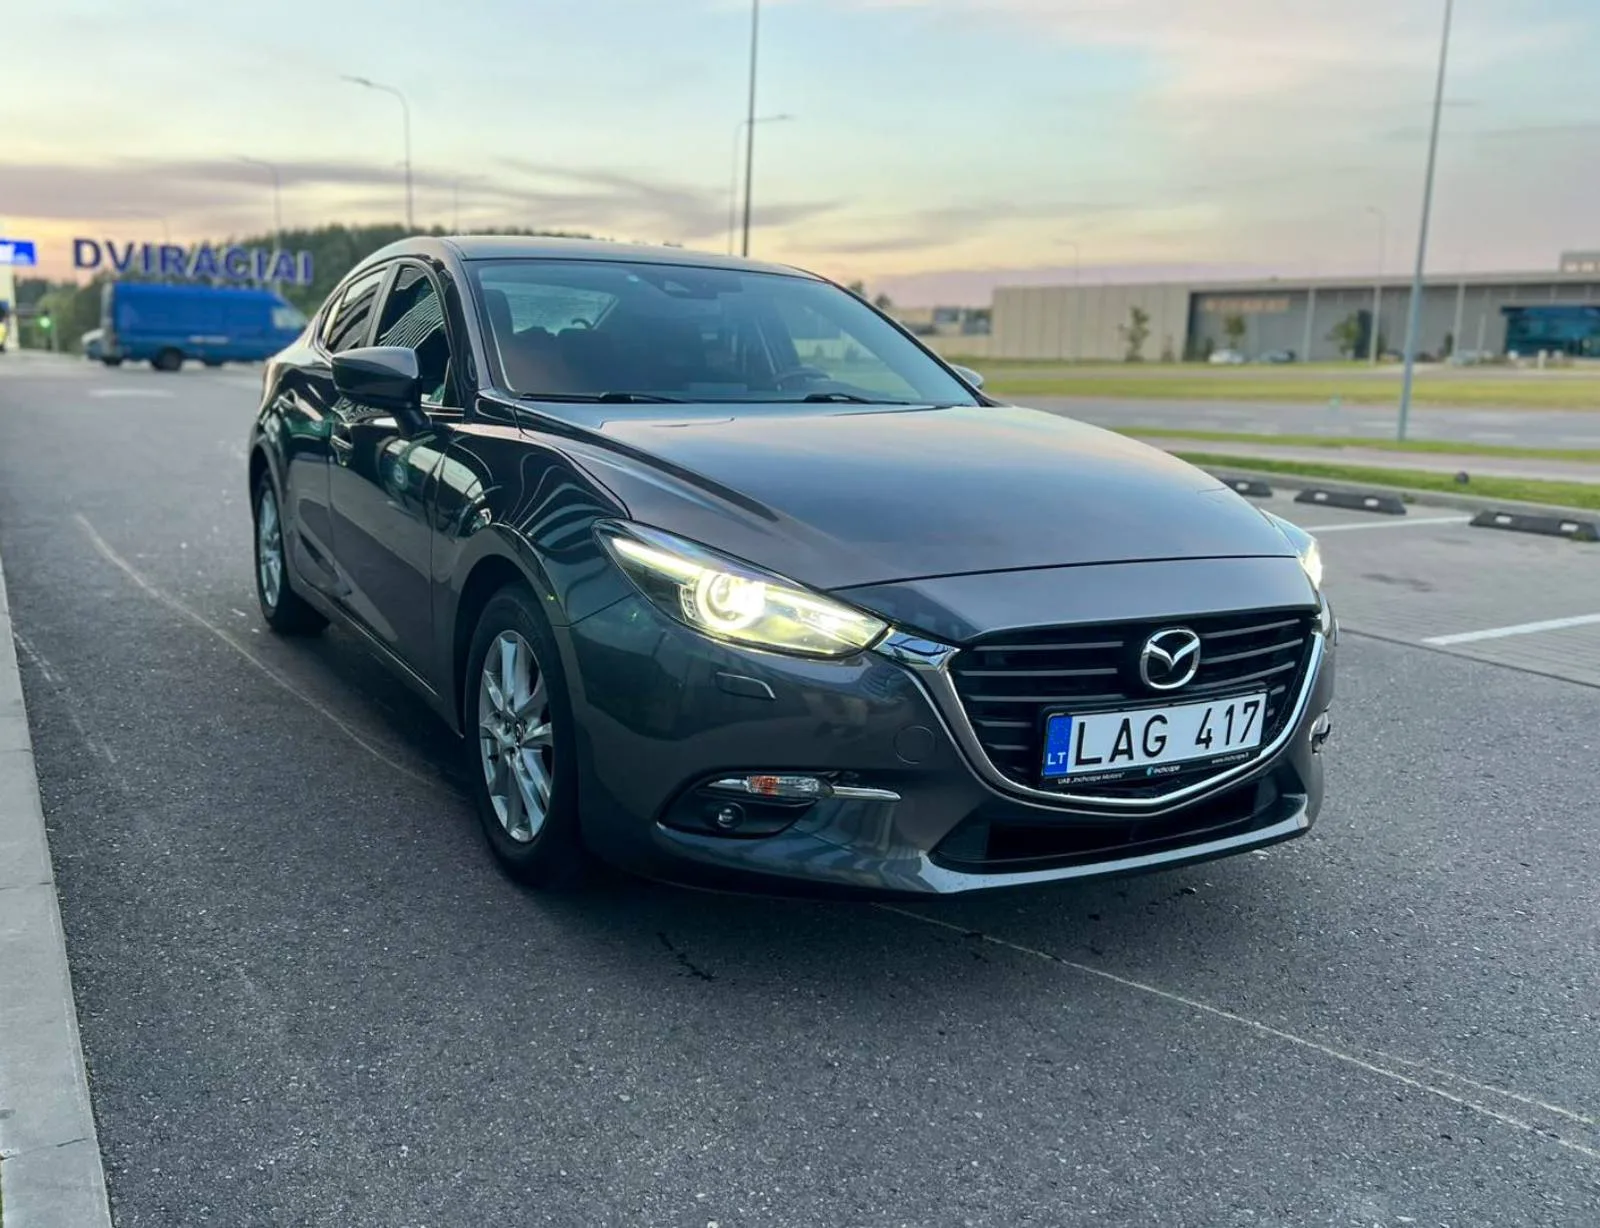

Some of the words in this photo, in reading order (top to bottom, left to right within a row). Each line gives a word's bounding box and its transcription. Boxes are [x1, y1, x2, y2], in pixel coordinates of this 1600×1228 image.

[1074, 714, 1168, 766] LAG
[1195, 700, 1260, 750] 417
[1047, 751, 1066, 765] LT
